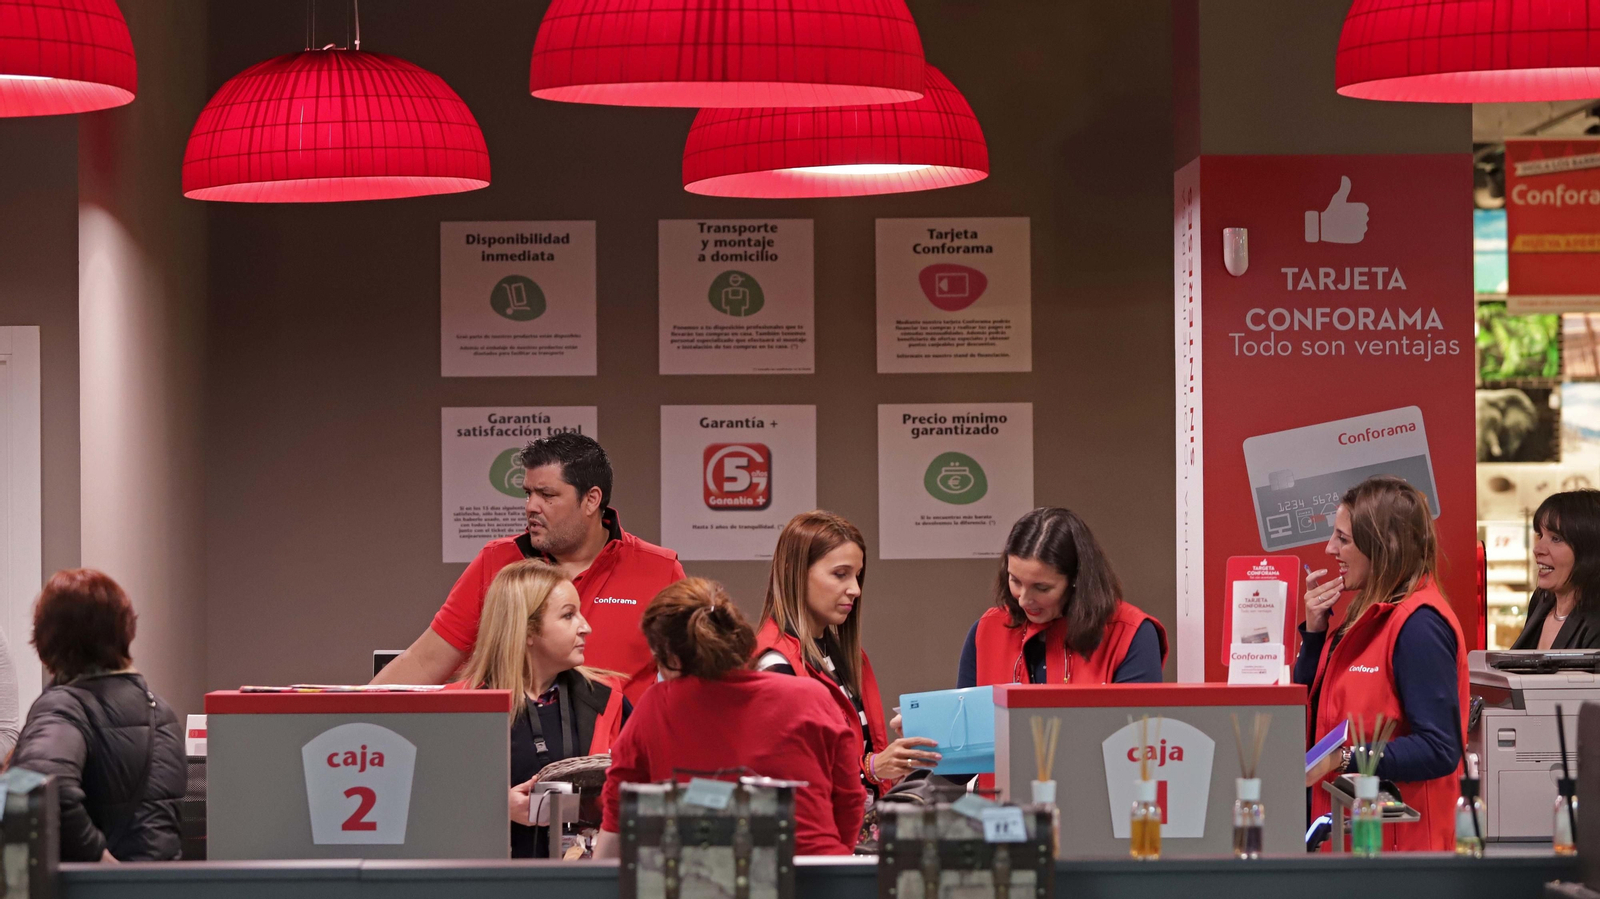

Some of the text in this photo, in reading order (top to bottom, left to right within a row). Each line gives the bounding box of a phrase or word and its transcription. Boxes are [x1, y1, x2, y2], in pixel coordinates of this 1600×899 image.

[698, 222, 778, 236] Transporte
[927, 228, 978, 242] Tarjeta
[466, 233, 570, 248] Disponibilidad
[701, 236, 774, 250] y montaje
[482, 250, 555, 261] inmediata
[913, 243, 993, 254] Conforama
[698, 251, 778, 262] a domicilio
[1281, 267, 1407, 290] TARJETA
[1245, 308, 1444, 331] CONFORAMA
[1229, 332, 1460, 362] Todo son ventajas
[488, 412, 550, 424] Garantía
[700, 416, 764, 429] Garantía
[903, 412, 1007, 424] Precio mínimo
[457, 425, 541, 437] satisfacción
[911, 424, 999, 439] garantizado
[1338, 422, 1416, 445] Conforama
[723, 457, 751, 492] 5
[1278, 492, 1339, 512] 1234 5678
[1231, 652, 1277, 661] Conforama
[327, 744, 384, 773] caja
[1127, 738, 1184, 767] caja
[341, 786, 377, 831] 2
